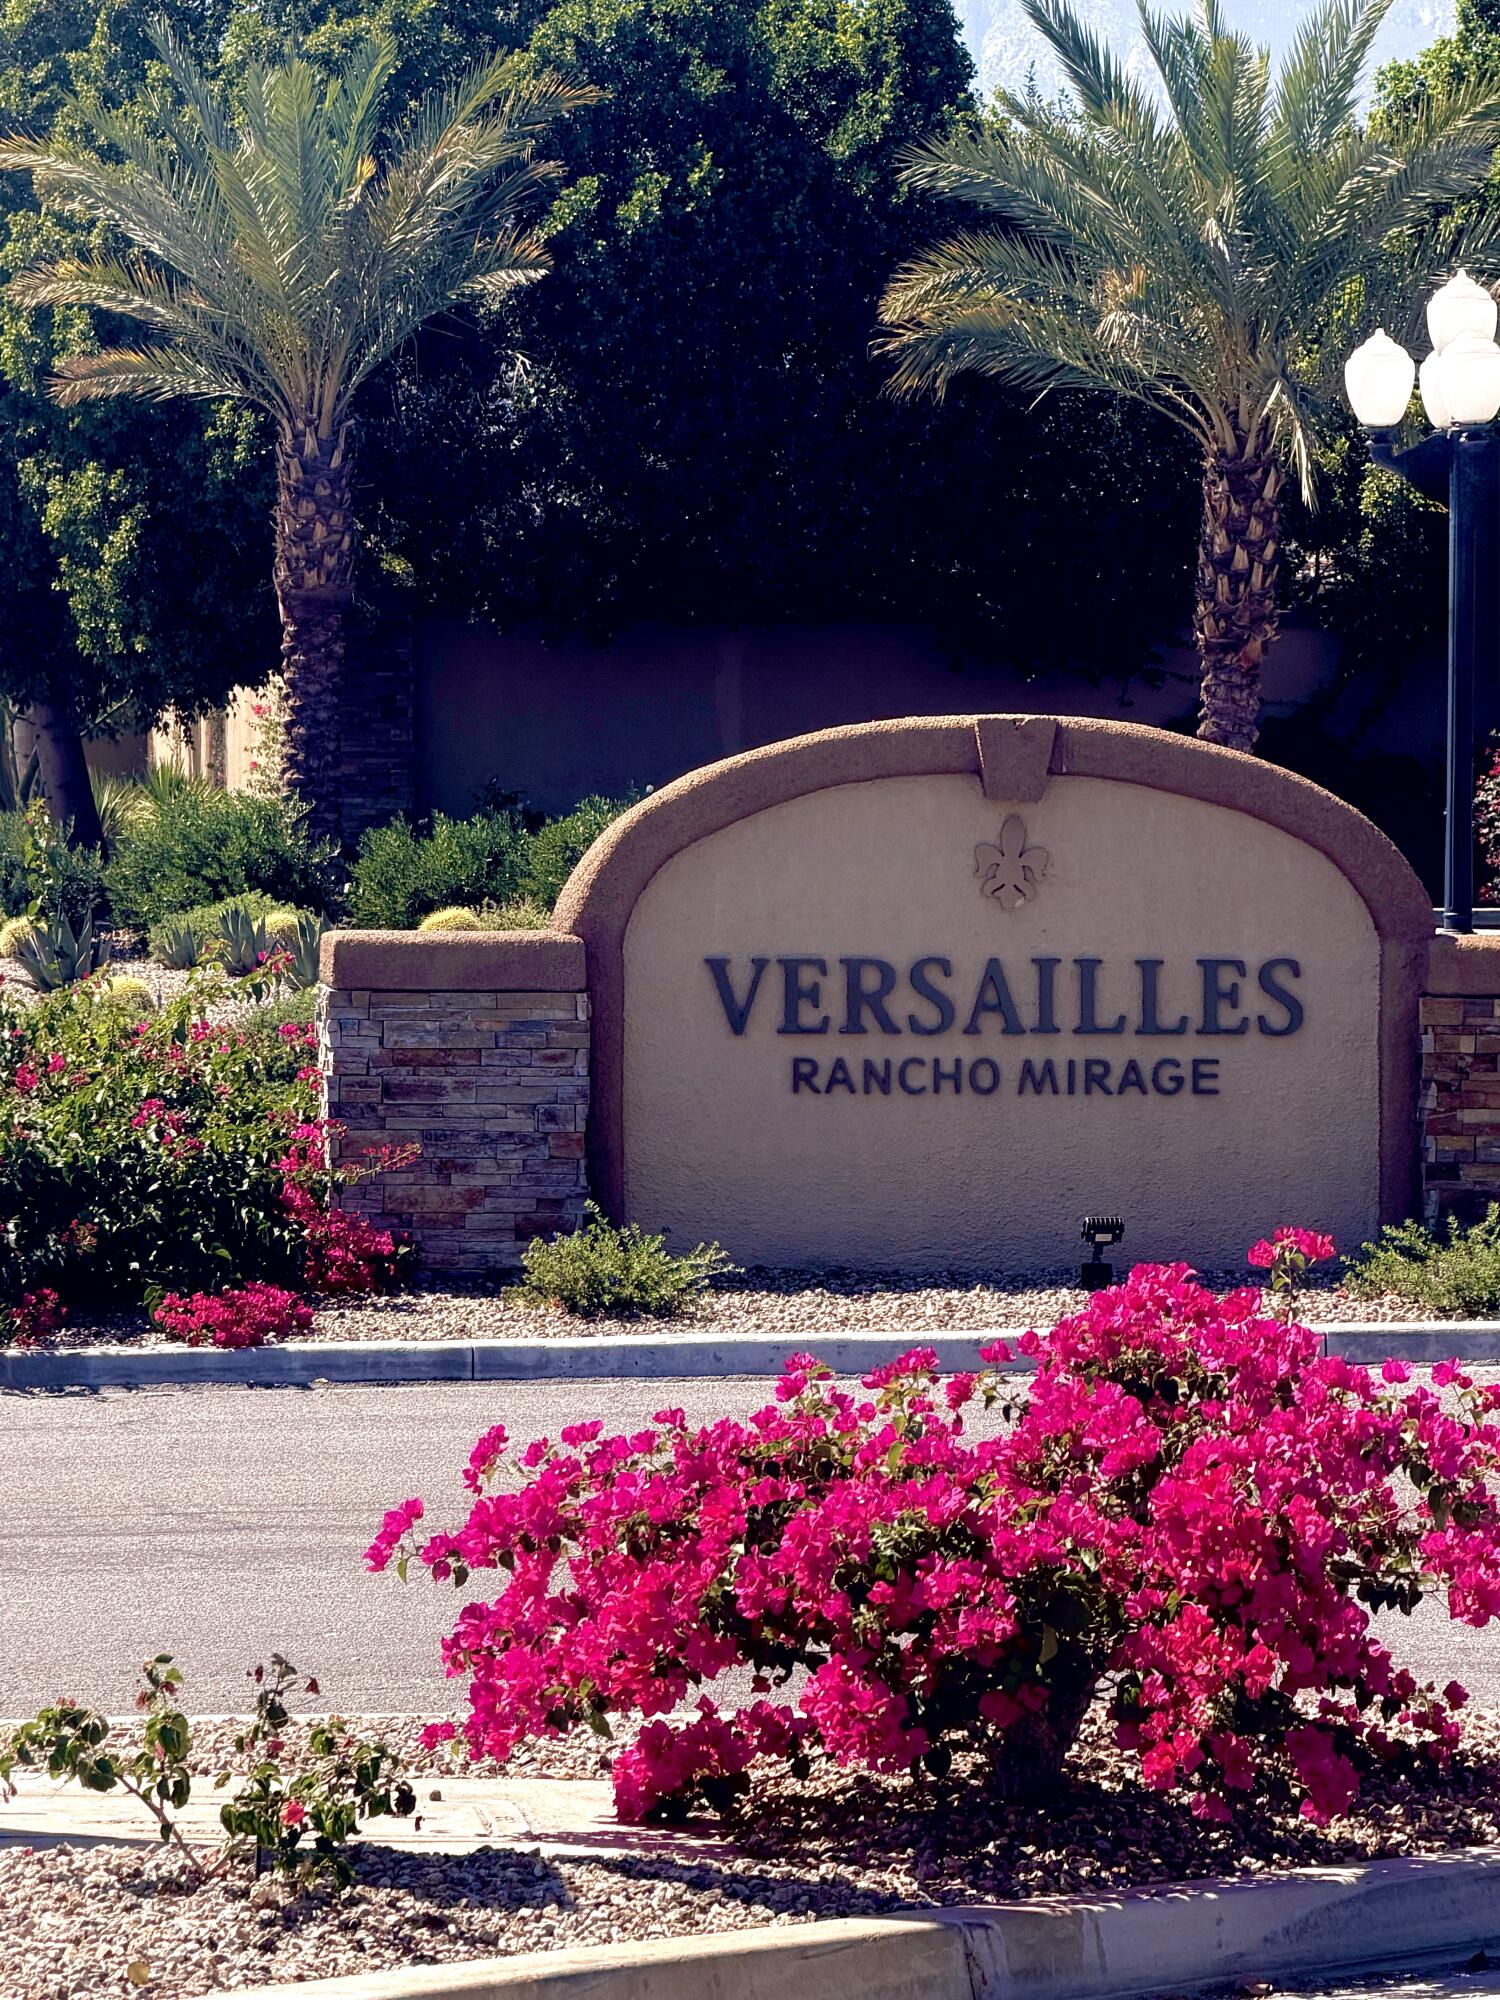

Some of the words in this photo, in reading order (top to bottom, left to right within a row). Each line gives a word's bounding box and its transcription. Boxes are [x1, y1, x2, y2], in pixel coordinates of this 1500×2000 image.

[704, 956, 1305, 1038] VERSAILLES
[791, 1056, 1001, 1097] RANCHO
[1016, 1057, 1221, 1097] MIRAGE
